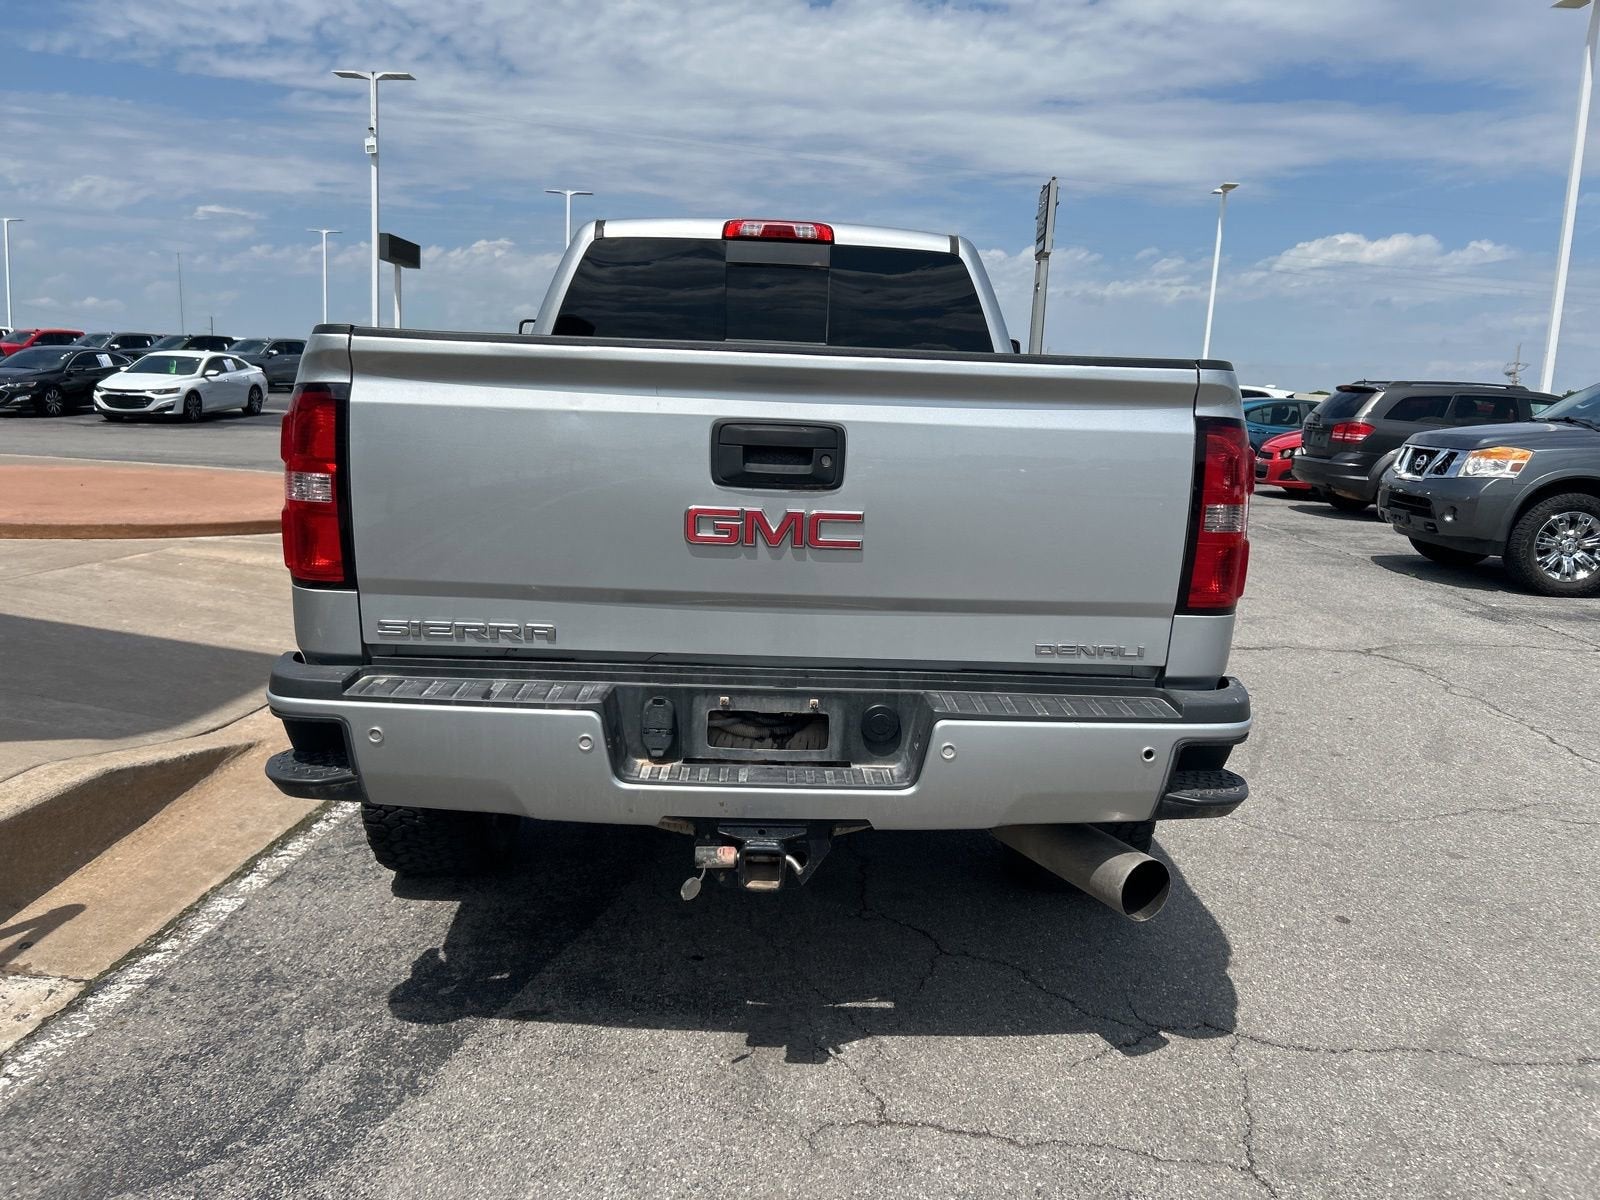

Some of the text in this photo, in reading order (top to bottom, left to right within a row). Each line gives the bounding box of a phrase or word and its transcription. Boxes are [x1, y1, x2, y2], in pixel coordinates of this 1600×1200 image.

[685, 505, 864, 550] GMC
[378, 619, 557, 642] SIERRA
[1034, 643, 1145, 658] DENALI
